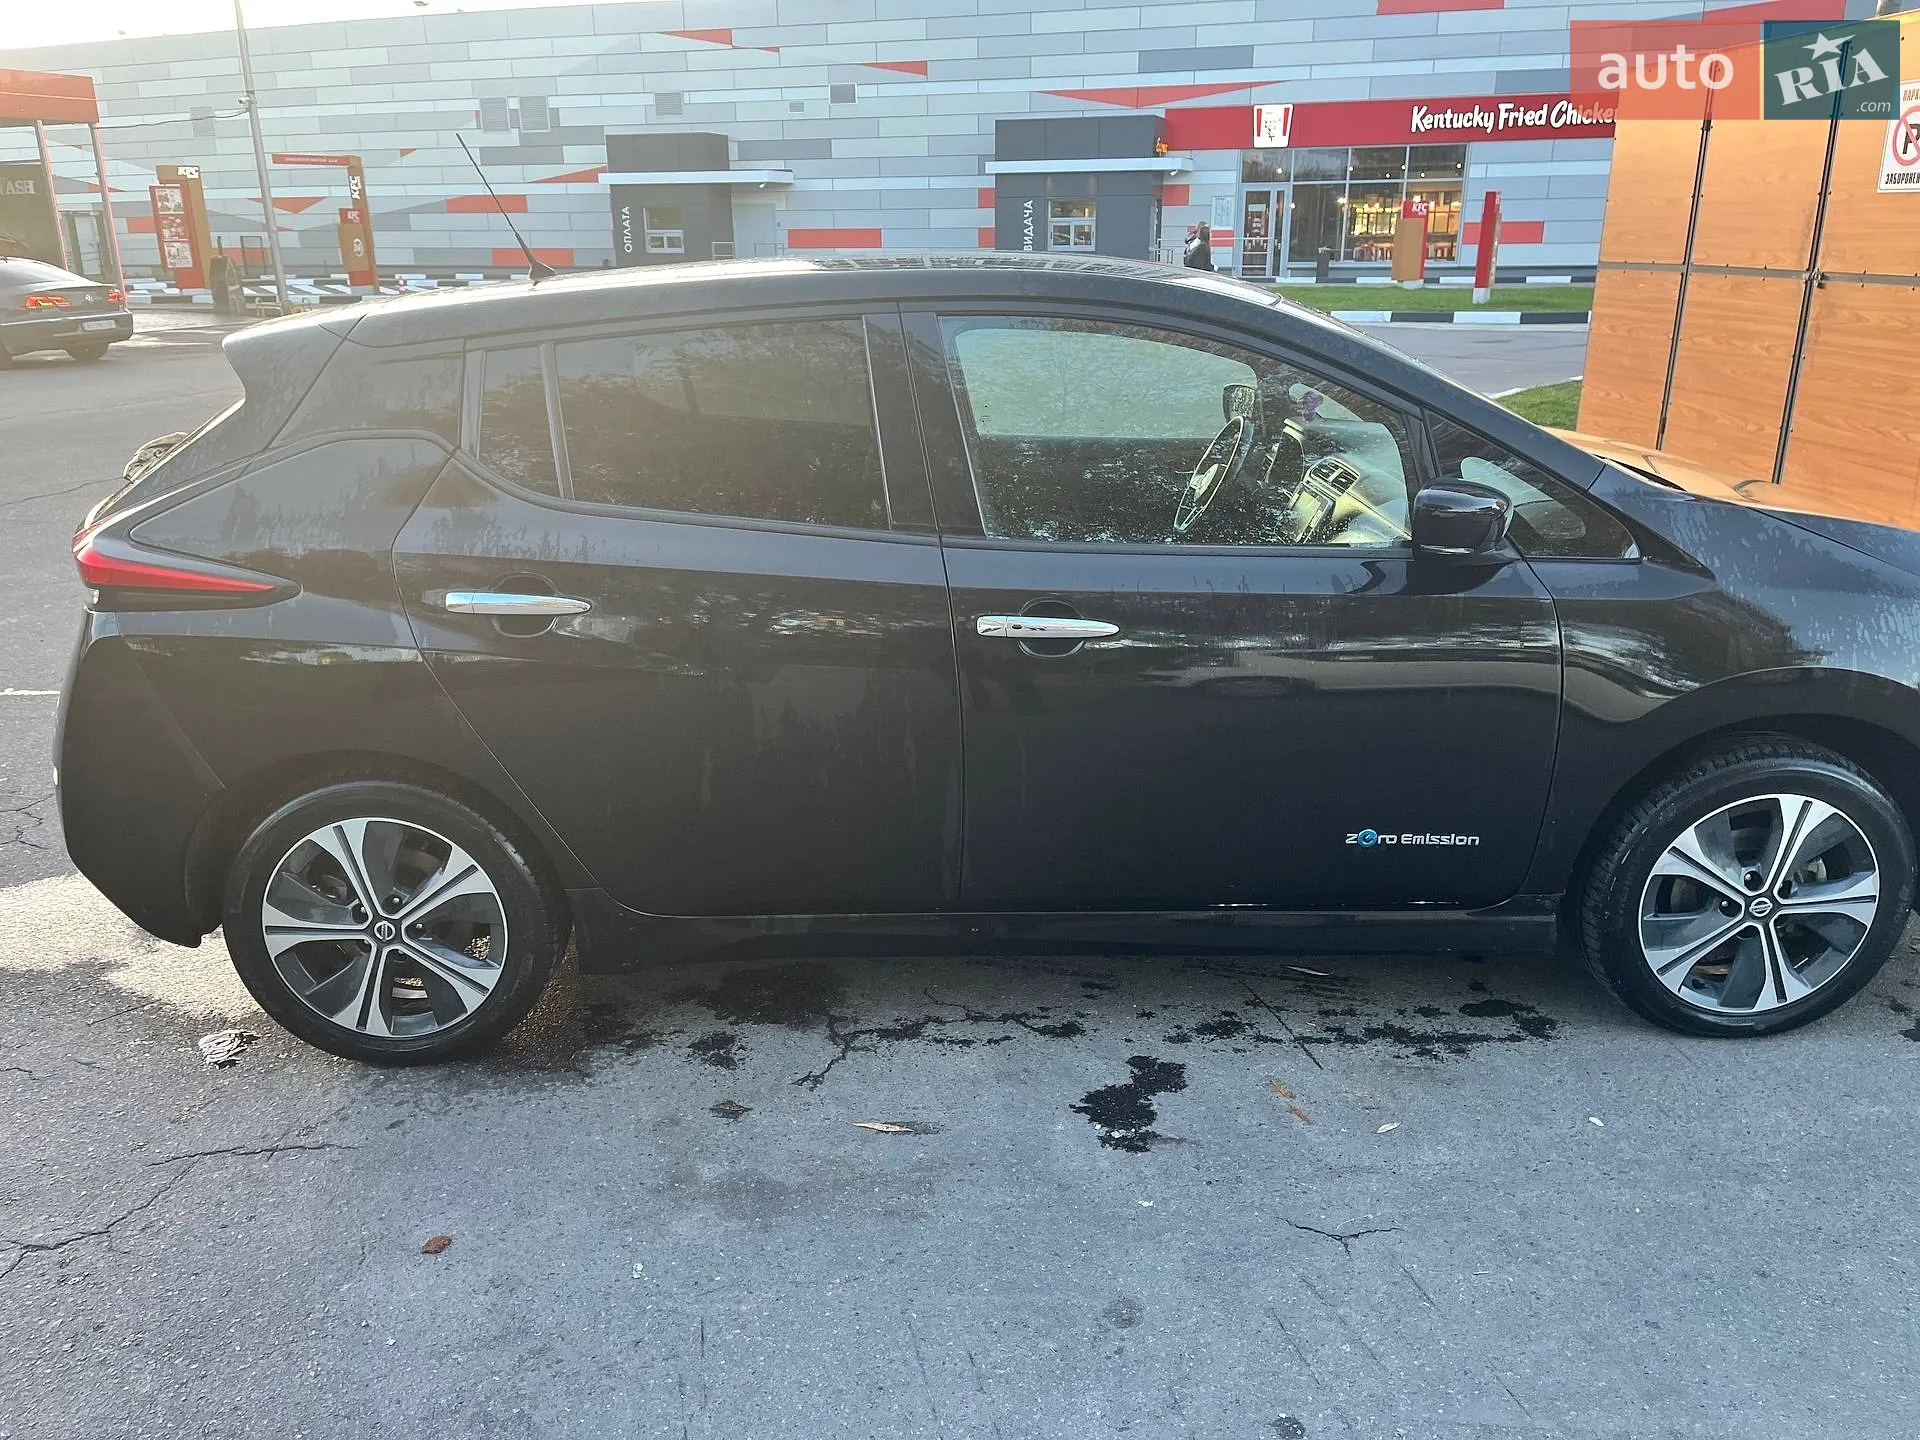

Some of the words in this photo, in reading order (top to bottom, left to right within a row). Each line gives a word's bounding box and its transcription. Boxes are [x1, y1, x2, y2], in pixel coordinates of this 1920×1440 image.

[1411, 104, 1494, 134] Kentucky
[1498, 102, 1548, 131] Fried
[349, 176, 361, 200] KFC
[1411, 203, 1428, 212] KFC
[621, 206, 633, 253] ОПЛАТА
[1024, 200, 1034, 251] ВИДАЧА
[1401, 833, 1480, 846] Emission
